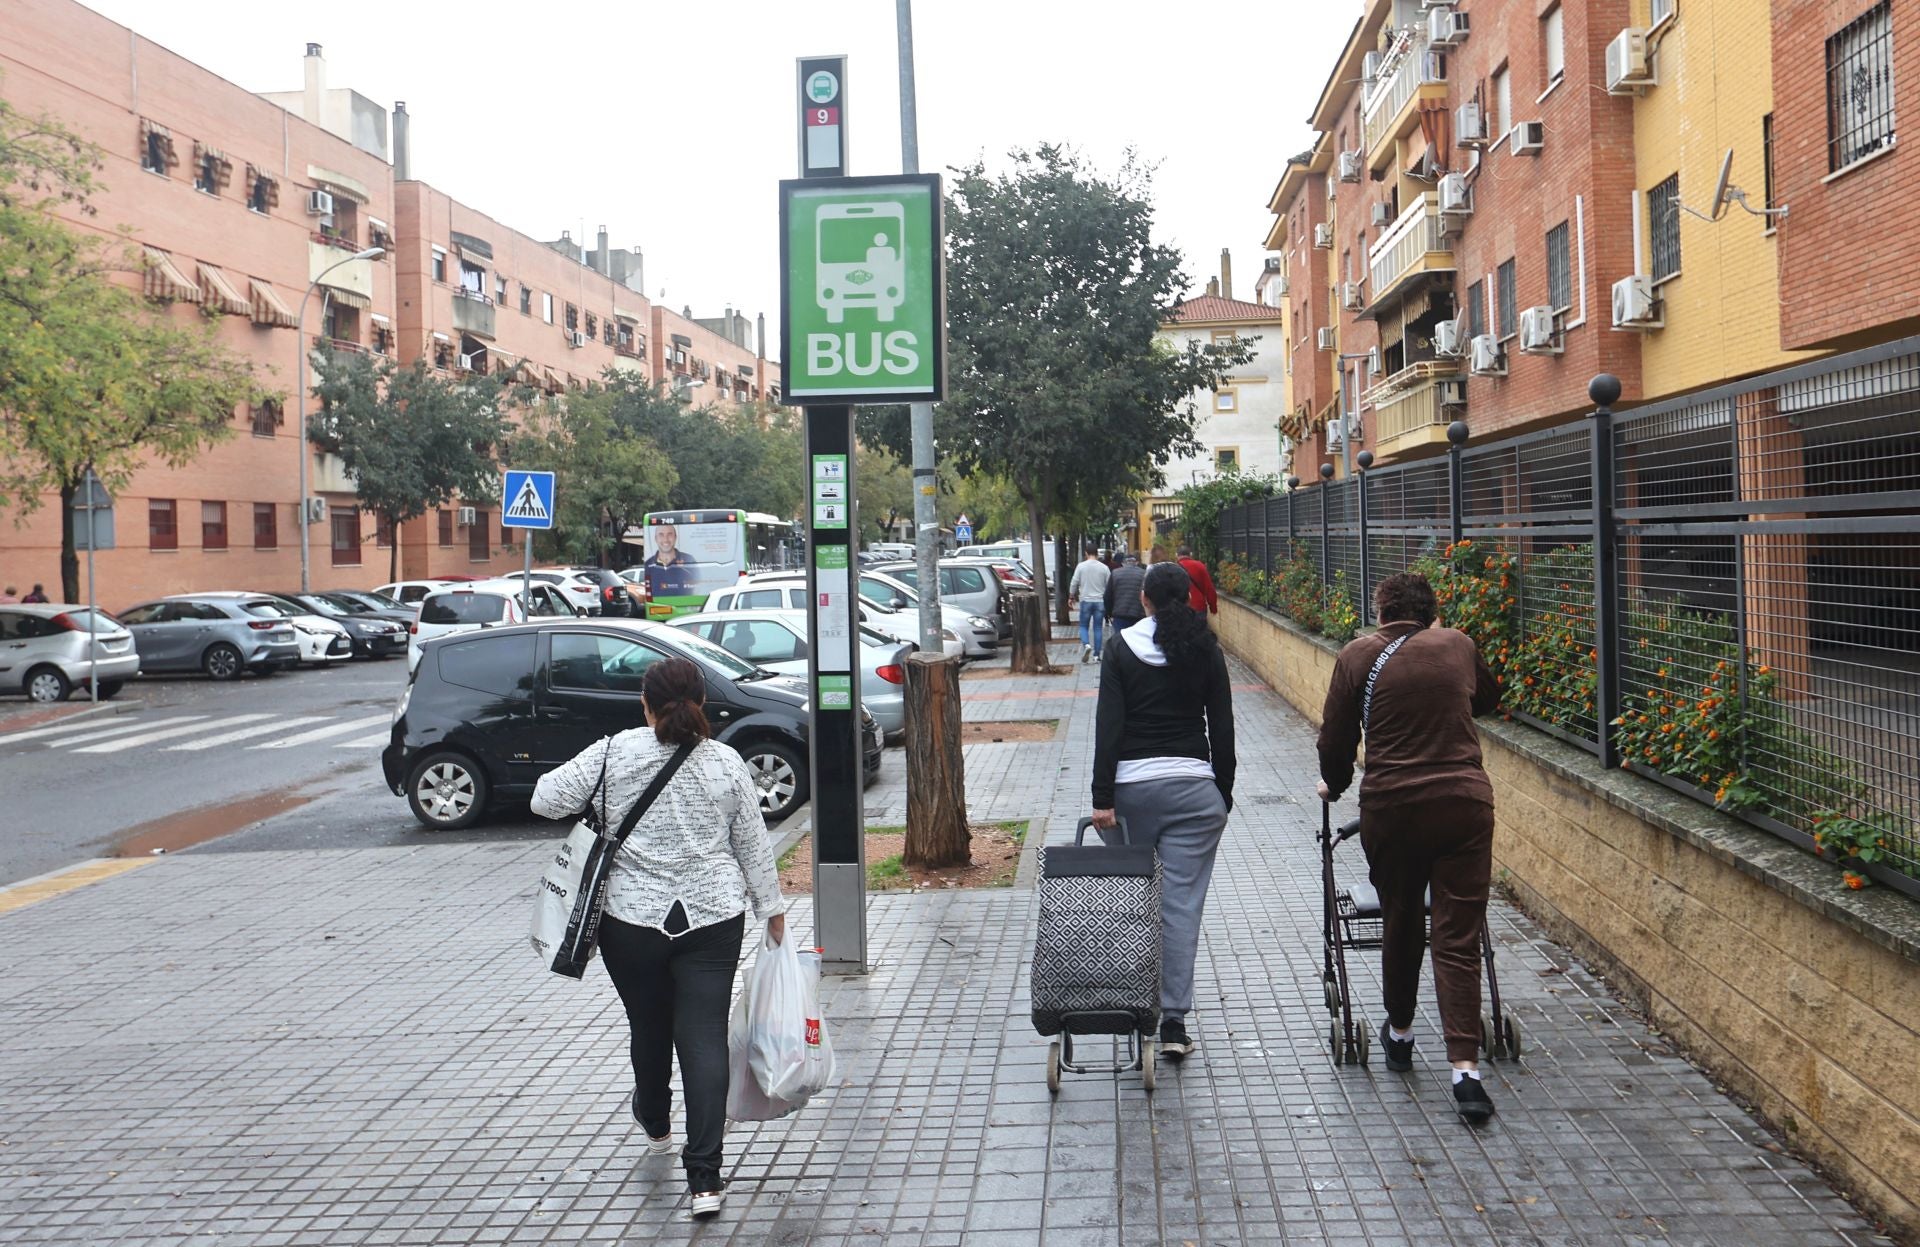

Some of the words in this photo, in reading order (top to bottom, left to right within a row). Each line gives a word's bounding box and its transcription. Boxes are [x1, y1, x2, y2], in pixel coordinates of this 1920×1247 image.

[817, 109, 829, 124] 9
[807, 330, 920, 377] BUS
[546, 881, 568, 898] TODO
